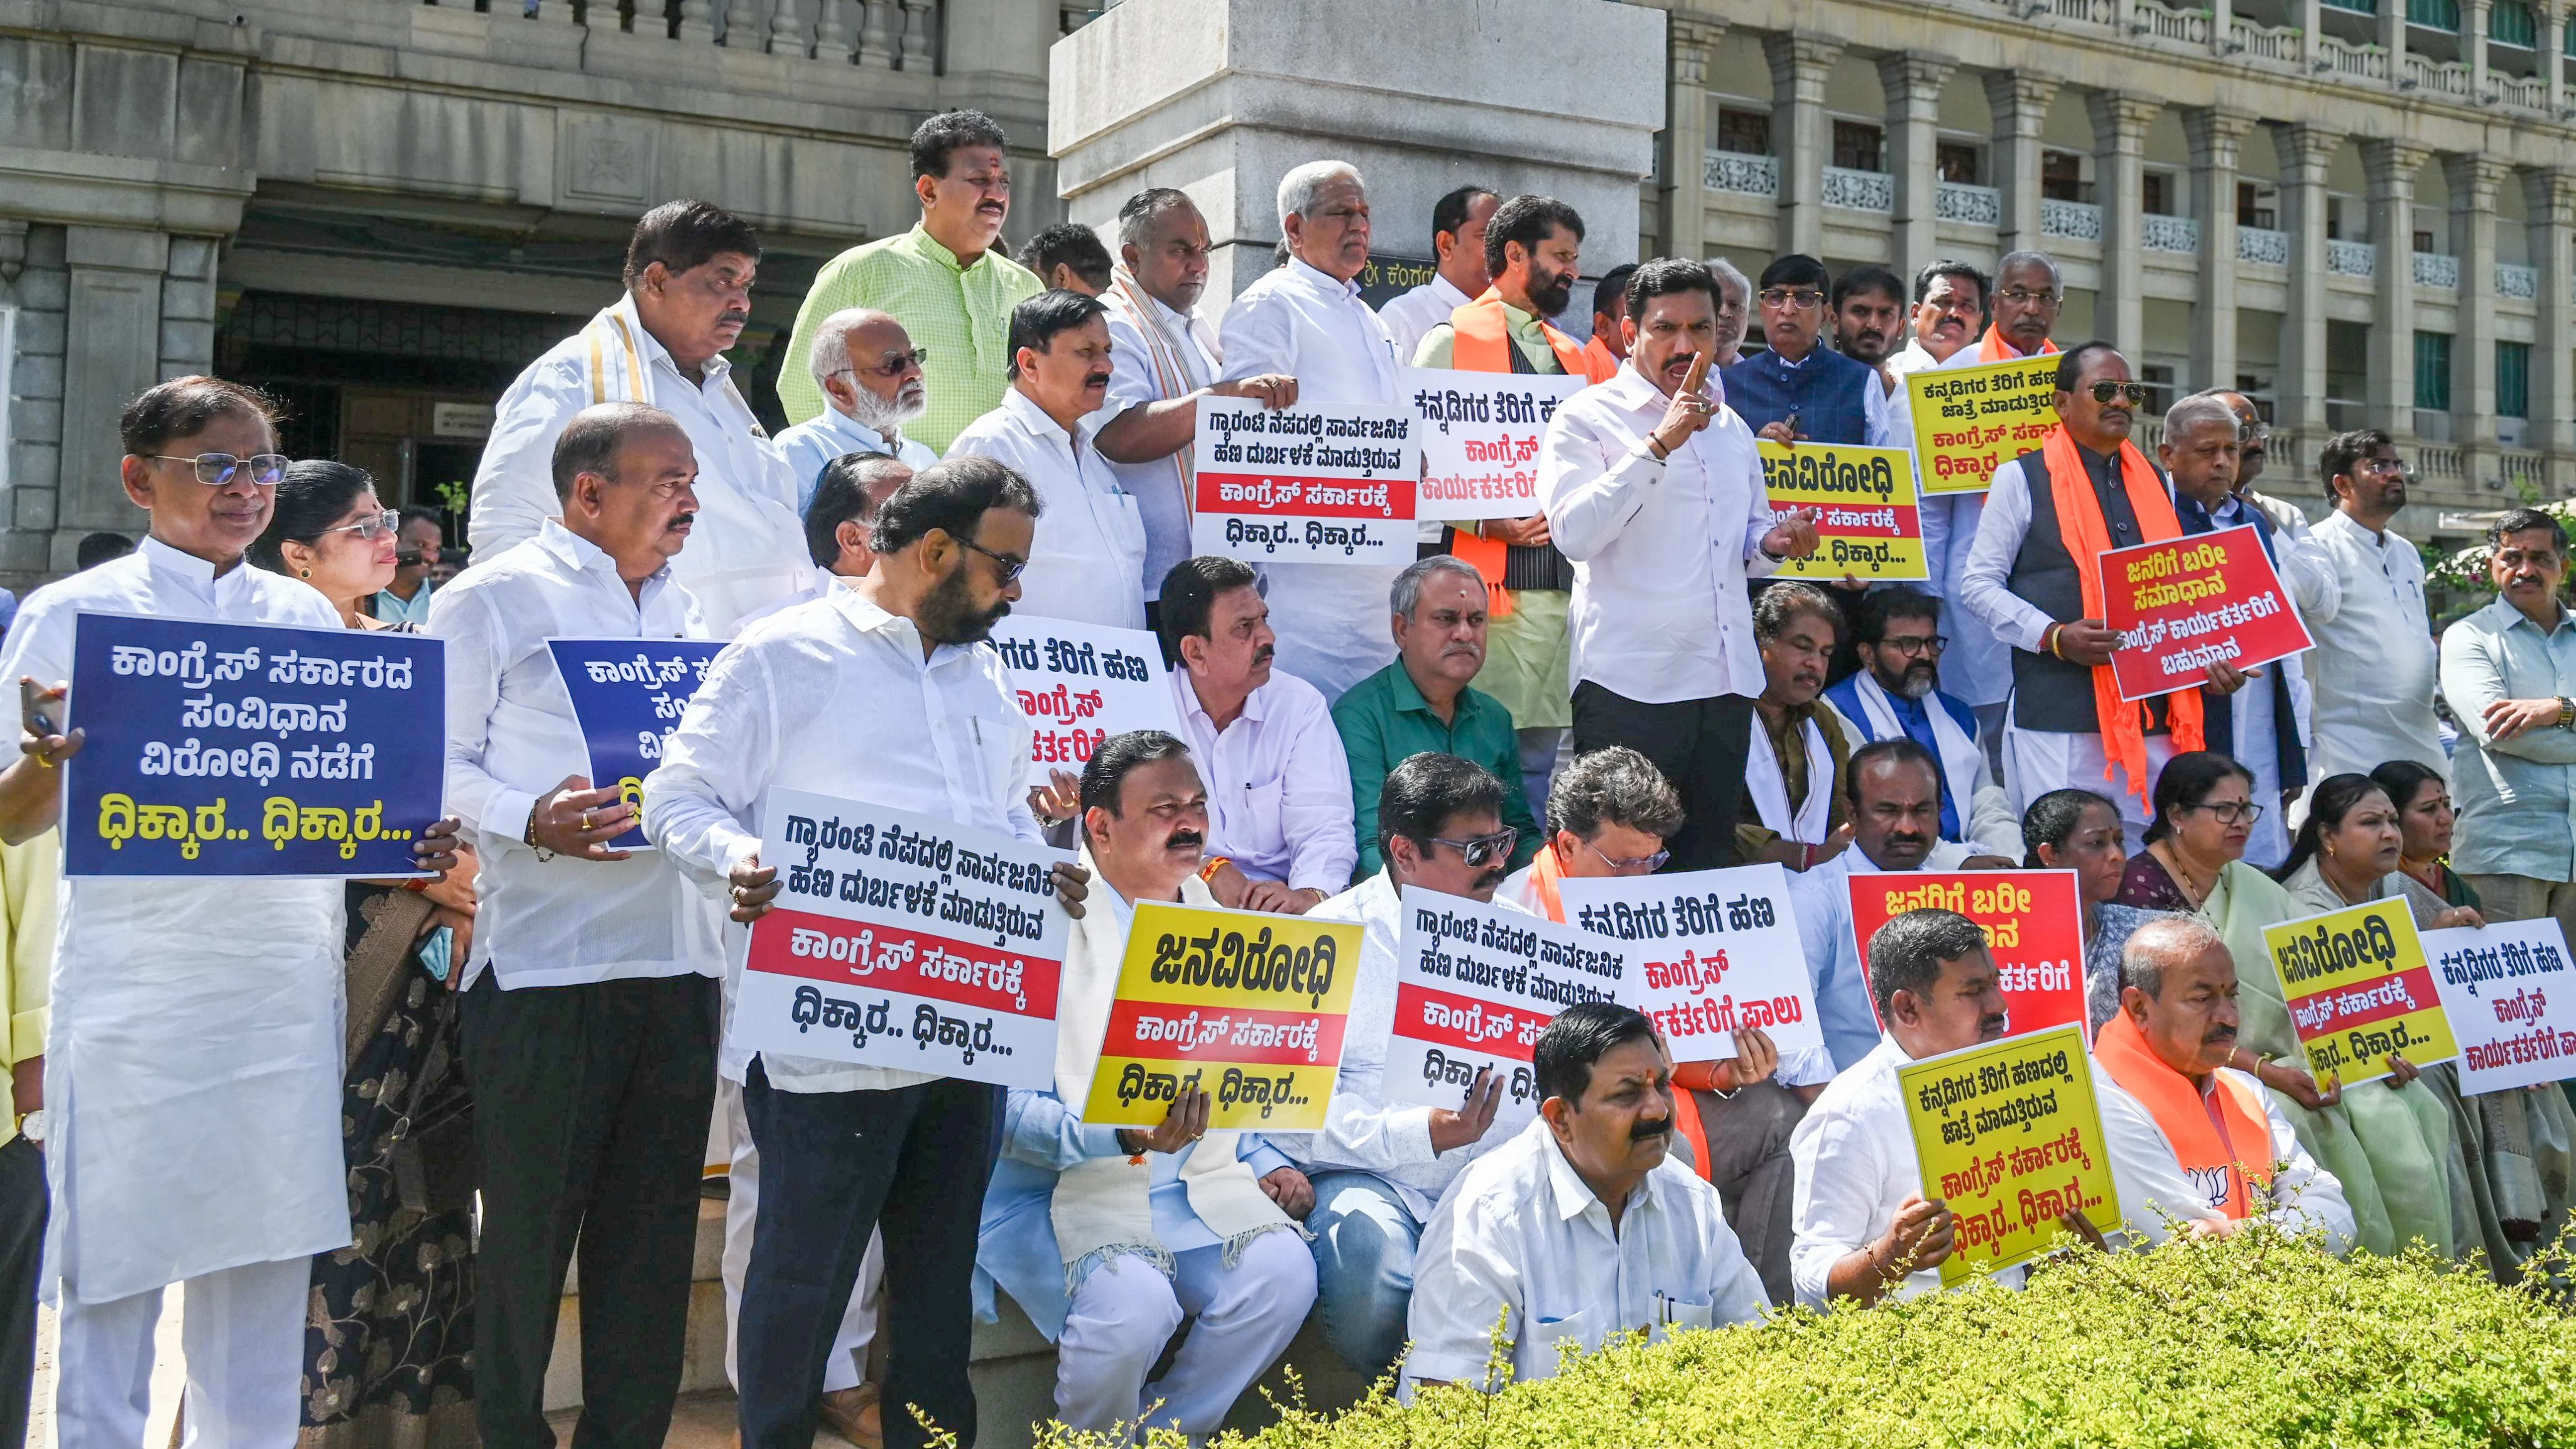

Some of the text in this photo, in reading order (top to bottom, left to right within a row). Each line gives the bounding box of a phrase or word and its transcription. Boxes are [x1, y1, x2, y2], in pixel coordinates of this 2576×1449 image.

[1365, 259, 1379, 287] ಶ್ರೀ
[1924, 377, 1987, 403] ಕನ್ನಡಿಗರ
[1991, 372, 2024, 391] ತೆರಿಗೆ
[1942, 399, 1977, 420] ಜಾತ್ರೆ
[1210, 410, 1408, 444] ಗ್ಯಾರಂಟಿ ನೆಪದಲ್ಲಿ ಸಾರ್ವಜನಿಕ
[1415, 389, 1489, 435] ಕನ್ನಡಿಗರ
[1494, 391, 1536, 423] ತೆರಿಗೆ
[1214, 441, 1400, 477] ಹಣ ದುರ್ಬಳಕೆ ಮಾಡುತ್ತಿರುವ
[1465, 433, 1538, 469] ಕಾಂಗ್ರೆಸ್
[1933, 425, 2007, 449] ಕಾಂಗ್ರೆಸ್
[1220, 479, 1392, 516] ಕಾಂಗ್ರೆಸ್ ಸರ್ಕಾರಕ್ಕೆ
[1760, 452, 1893, 502] ಜನವಿರೋಧಿ
[1226, 519, 1383, 555] ಧಿಕ್ಕಾರ.. ಧಿಕ್ಕಾರ...
[1827, 508, 1900, 535] ಸರ್ಕಾರಕ್ಕೆ
[1832, 540, 1906, 572] ಧಿಕ್ಕಾರ...
[2128, 543, 2227, 583] ಜನರಿಗೆ ಬರೀ
[2134, 570, 2227, 611] ಸಮಾಧಾನ
[2169, 591, 2281, 639] ಕಾರ್ಯಕರ್ತರಿಗೆ
[112, 641, 412, 690] ಕಾಂಗ್ರೆಸ್ ಸರ್ಕಾರದ
[584, 654, 688, 690] ಕಾಂಗ್ರೆಸ್
[1044, 638, 1099, 676] ತೆರಿಗೆ
[1101, 649, 1149, 682] ಹಣ
[2161, 636, 2242, 675] ಬಹುಮಾನ
[183, 694, 347, 739] ಸಂವಿಧಾನ
[141, 741, 374, 786] ವಿರೋಧಿ ನಡೆಗೆ
[98, 793, 411, 860] ಧಿಕ್ಕಾರ.. ಧಿಕ್ಕಾರ...
[786, 815, 1055, 897] ಗ್ಯಾರಂಟಿ ನೆಪದಲ್ಲಿ ಸಾರ್ವಜನಿಕ
[789, 864, 1044, 947] ಹಣ ದುರ್ಬಳಕೆ ಮಾಡುತ್ತಿರುವ
[1672, 894, 1724, 937] ತೆರಿಗೆ
[1727, 893, 1776, 931] ಹಣ
[1972, 882, 2031, 914] ಬರೀ
[1416, 908, 1623, 980] ಗ್ಯಾರಂಟಿ ನೆಪದಲ್ಲಿ ಸಾರ್ವಜನಿಕ
[2278, 914, 2396, 984] ಜನವಿರೋಧಿ
[791, 927, 1028, 1011] ಕಾಂಗ್ರೆಸ್ ಸರ್ಕಾರಕ್ಕೆ
[1151, 927, 1336, 1009] ಜನವಿರೋಧಿ
[1420, 946, 1452, 976] ಹಣ
[1456, 955, 1527, 995] ದುರ್ಬಳಕೆ
[1644, 949, 1729, 995] ಕಾಂಗ್ರೆಸ್
[2440, 941, 2563, 997] ಕನ್ನಡಿಗರ ತೆರಿಗೆ ಹಣ
[791, 985, 1013, 1066] ಧಿಕ್ಕಾರ.. ಧಿಕ್ಕಾರ...
[1423, 1001, 1513, 1043] ಕಾಂಗ್ರೆಸ್
[2296, 977, 2416, 1029] ಕಾಂಗ್ರೆಸ್ ಸರ್ಕಾರಕ್ಕೆ
[2492, 987, 2546, 1026] ಕಾಂಗ್ರೆಸ್
[1136, 1011, 1320, 1062] ಕಾಂಗ್ರೆಸ್ ಸರ್ಕಾರಕ್ಕೆ
[2466, 1026, 2560, 1072] ಕಾರ್ಯಕರ್ತರಿಗೆ
[1218, 1068, 1309, 1119] ಧಿಕ್ಕಾರ...
[1918, 1050, 2073, 1119] ಕನ್ನಡಿಗರ ತೆರಿಗೆ ಹಣದಲ್ಲಿ
[1941, 1088, 2058, 1146] ಜಾತ್ರೆ ಮಾಡುತ್ತಿರುವ
[1940, 1127, 2092, 1198] ಕಾಂಗ್ರೆಸ್ ಸರ್ಕಾರಕ್ಕೆ
[1952, 1199, 2018, 1261] ಧಿಕ್ಕಾರ..
